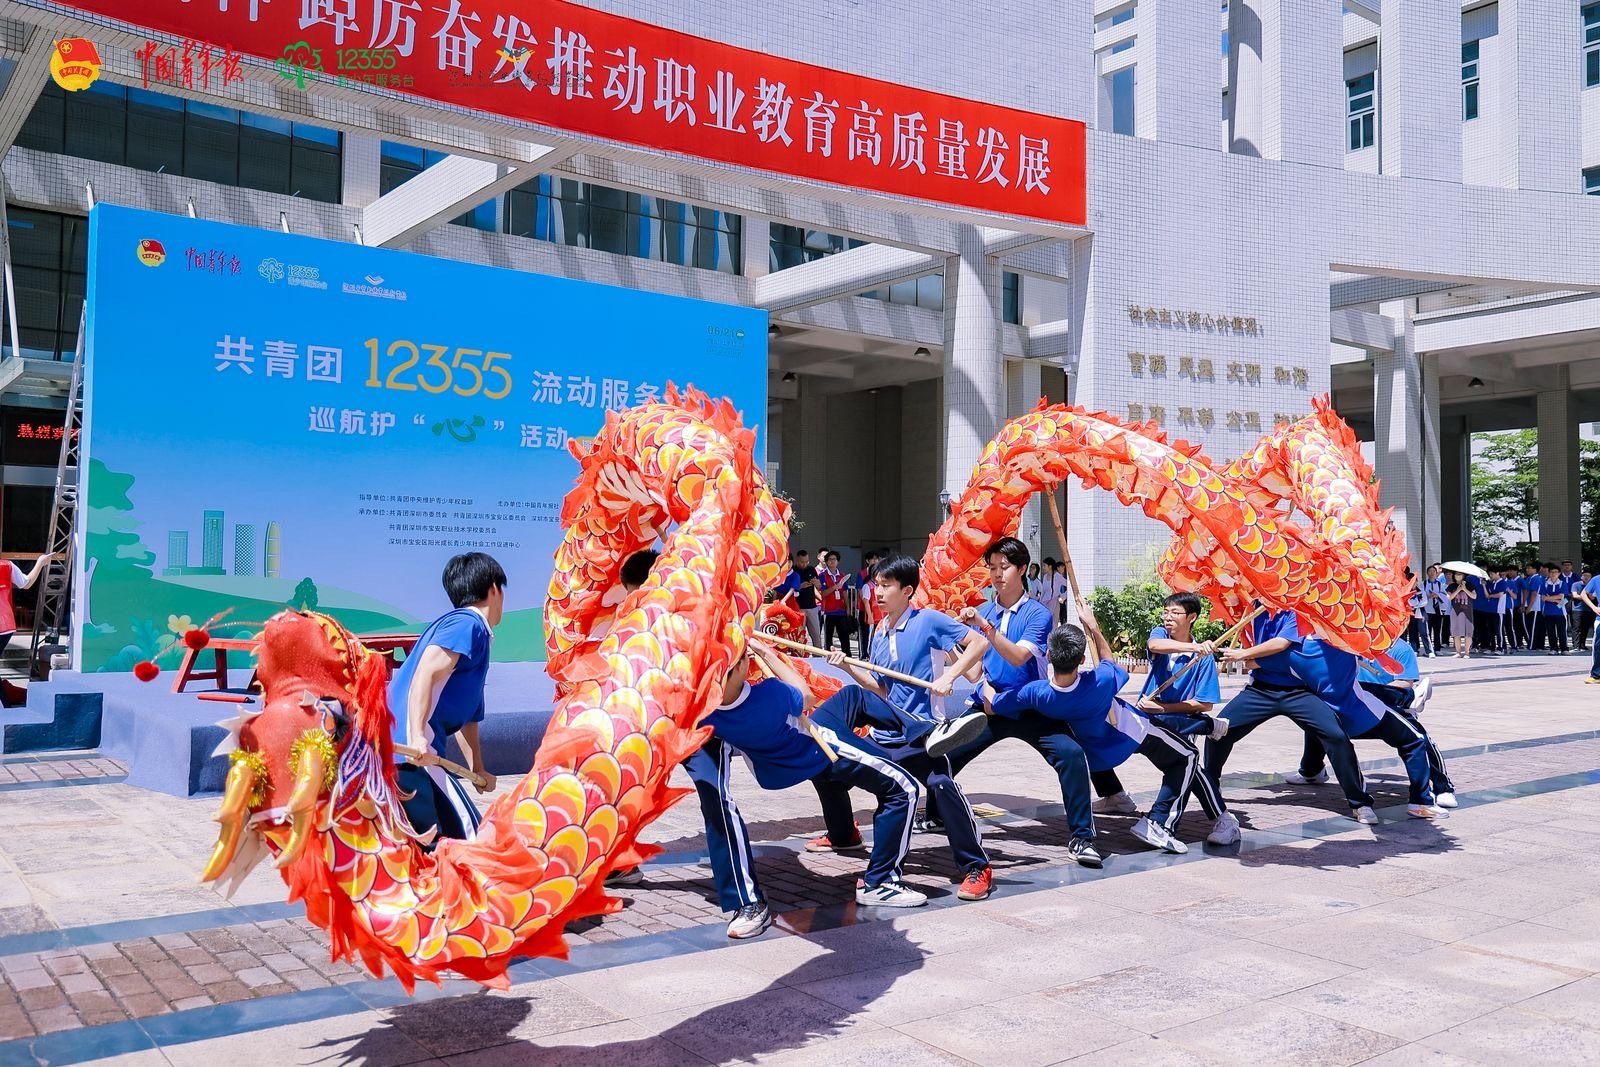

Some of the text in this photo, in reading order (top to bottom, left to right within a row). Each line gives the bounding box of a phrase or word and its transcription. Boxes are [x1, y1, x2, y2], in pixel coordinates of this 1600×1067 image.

[214, 334, 692, 411] 共青团 12355 流动服务
